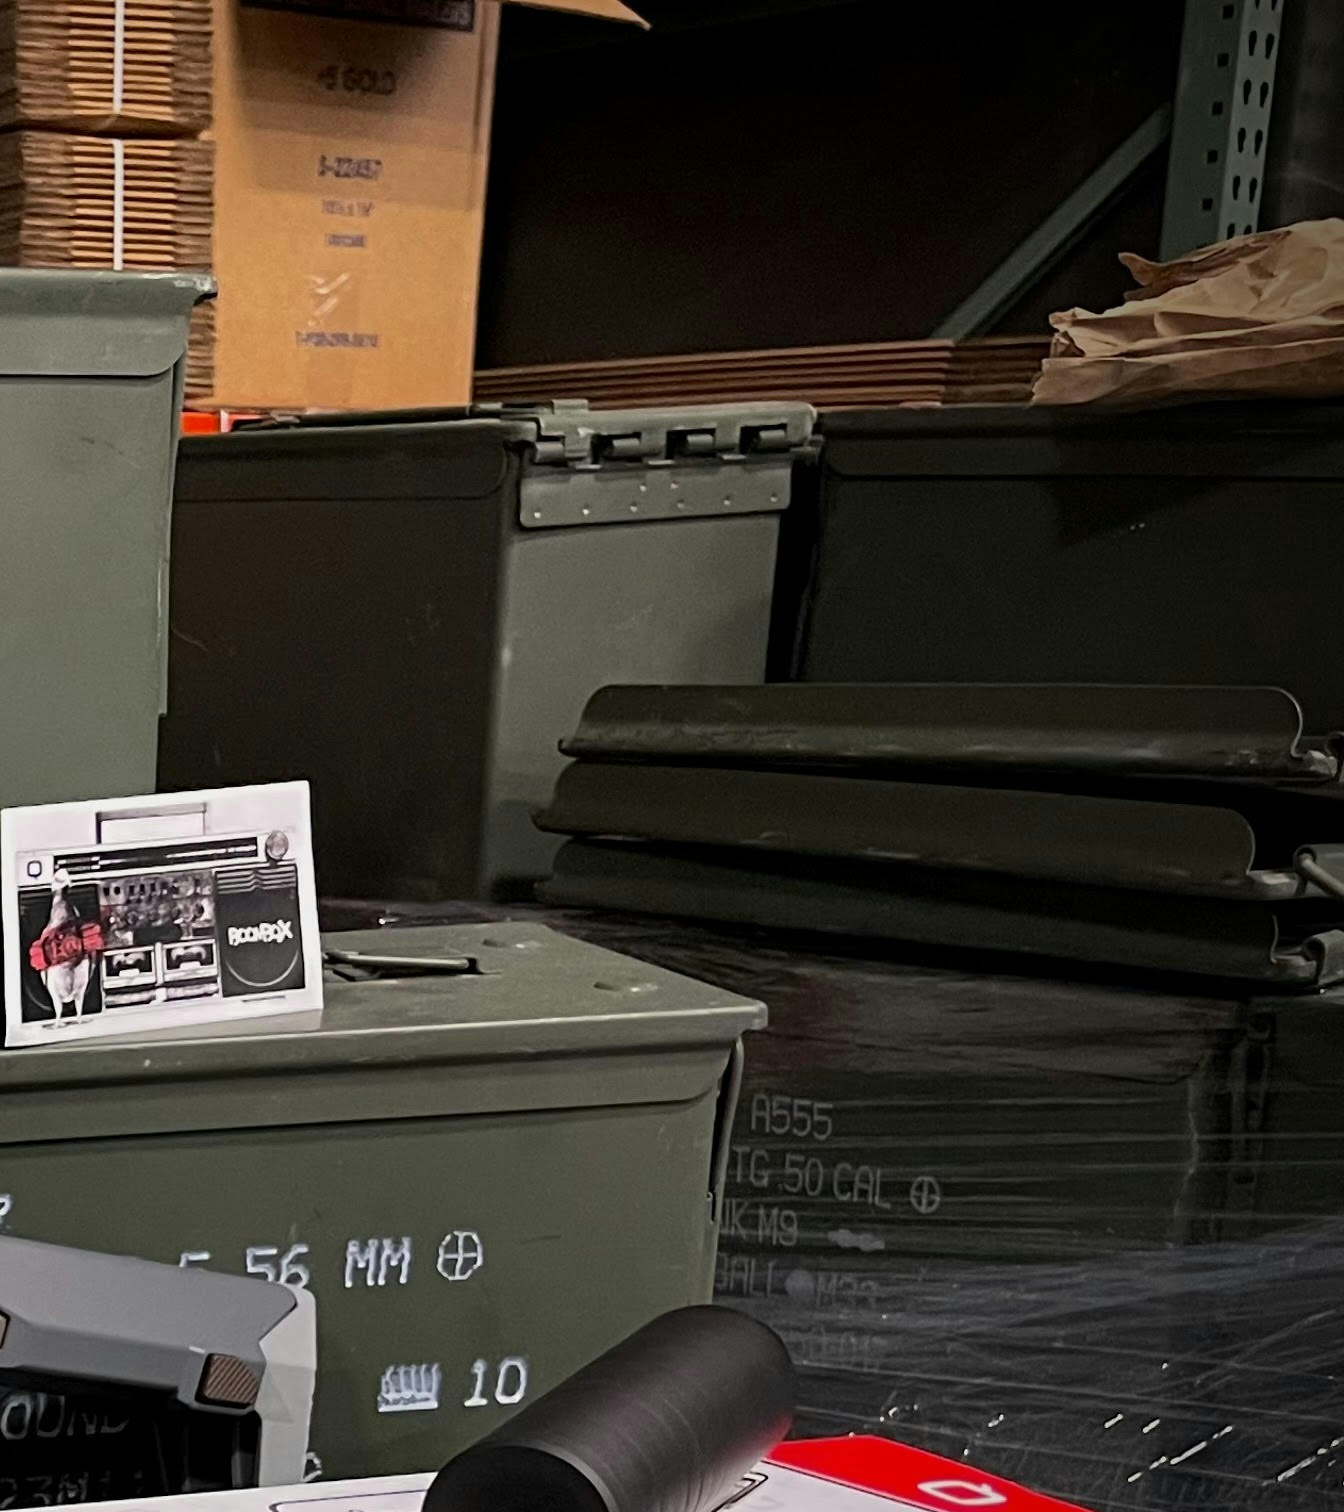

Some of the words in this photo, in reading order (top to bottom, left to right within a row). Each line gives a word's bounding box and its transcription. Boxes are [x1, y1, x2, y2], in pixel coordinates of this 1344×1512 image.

[750, 1094, 833, 1140] A555
[833, 1162, 891, 1209] CAL
[344, 1236, 411, 1288] MM
[463, 1357, 528, 1408] 10
